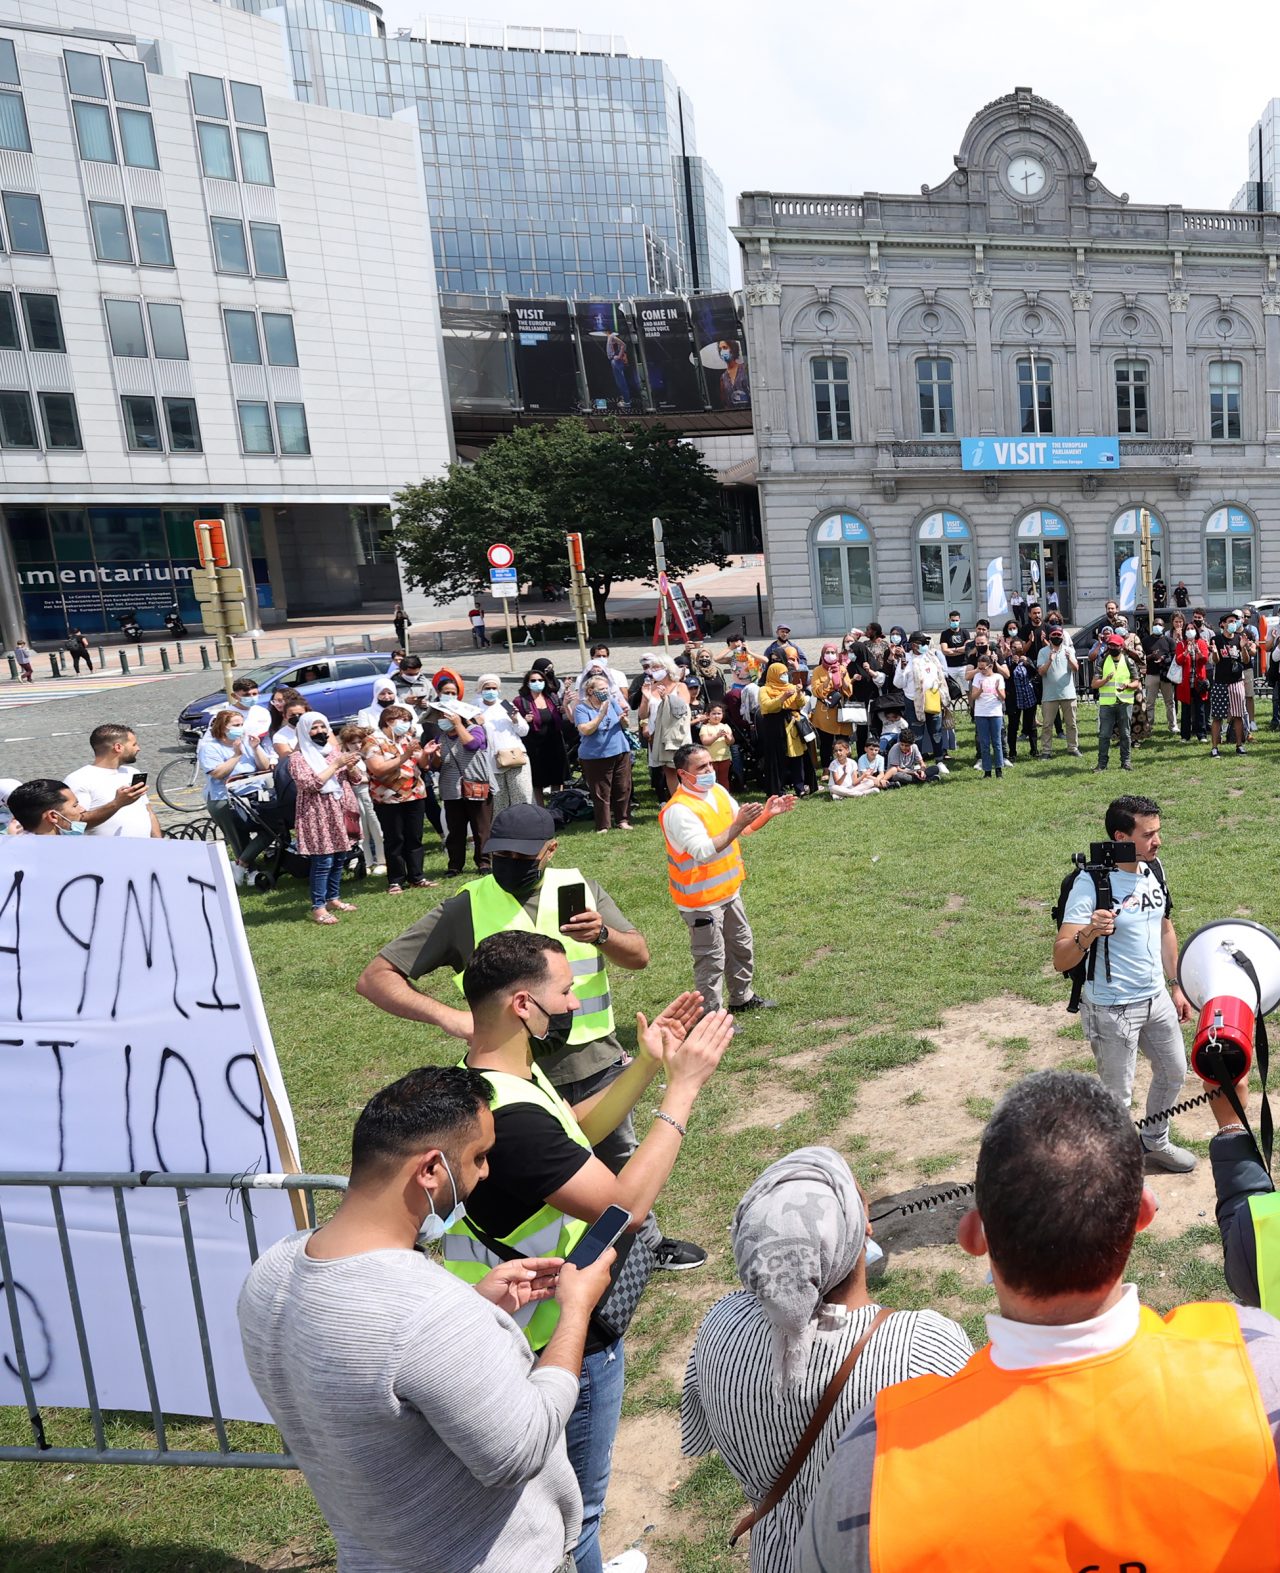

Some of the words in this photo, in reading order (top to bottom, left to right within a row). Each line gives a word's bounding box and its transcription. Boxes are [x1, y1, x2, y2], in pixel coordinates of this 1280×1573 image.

[516, 309, 544, 319] VISIT
[642, 310, 666, 320] COME
[667, 309, 678, 319] IN
[993, 442, 1047, 465] VISIT
